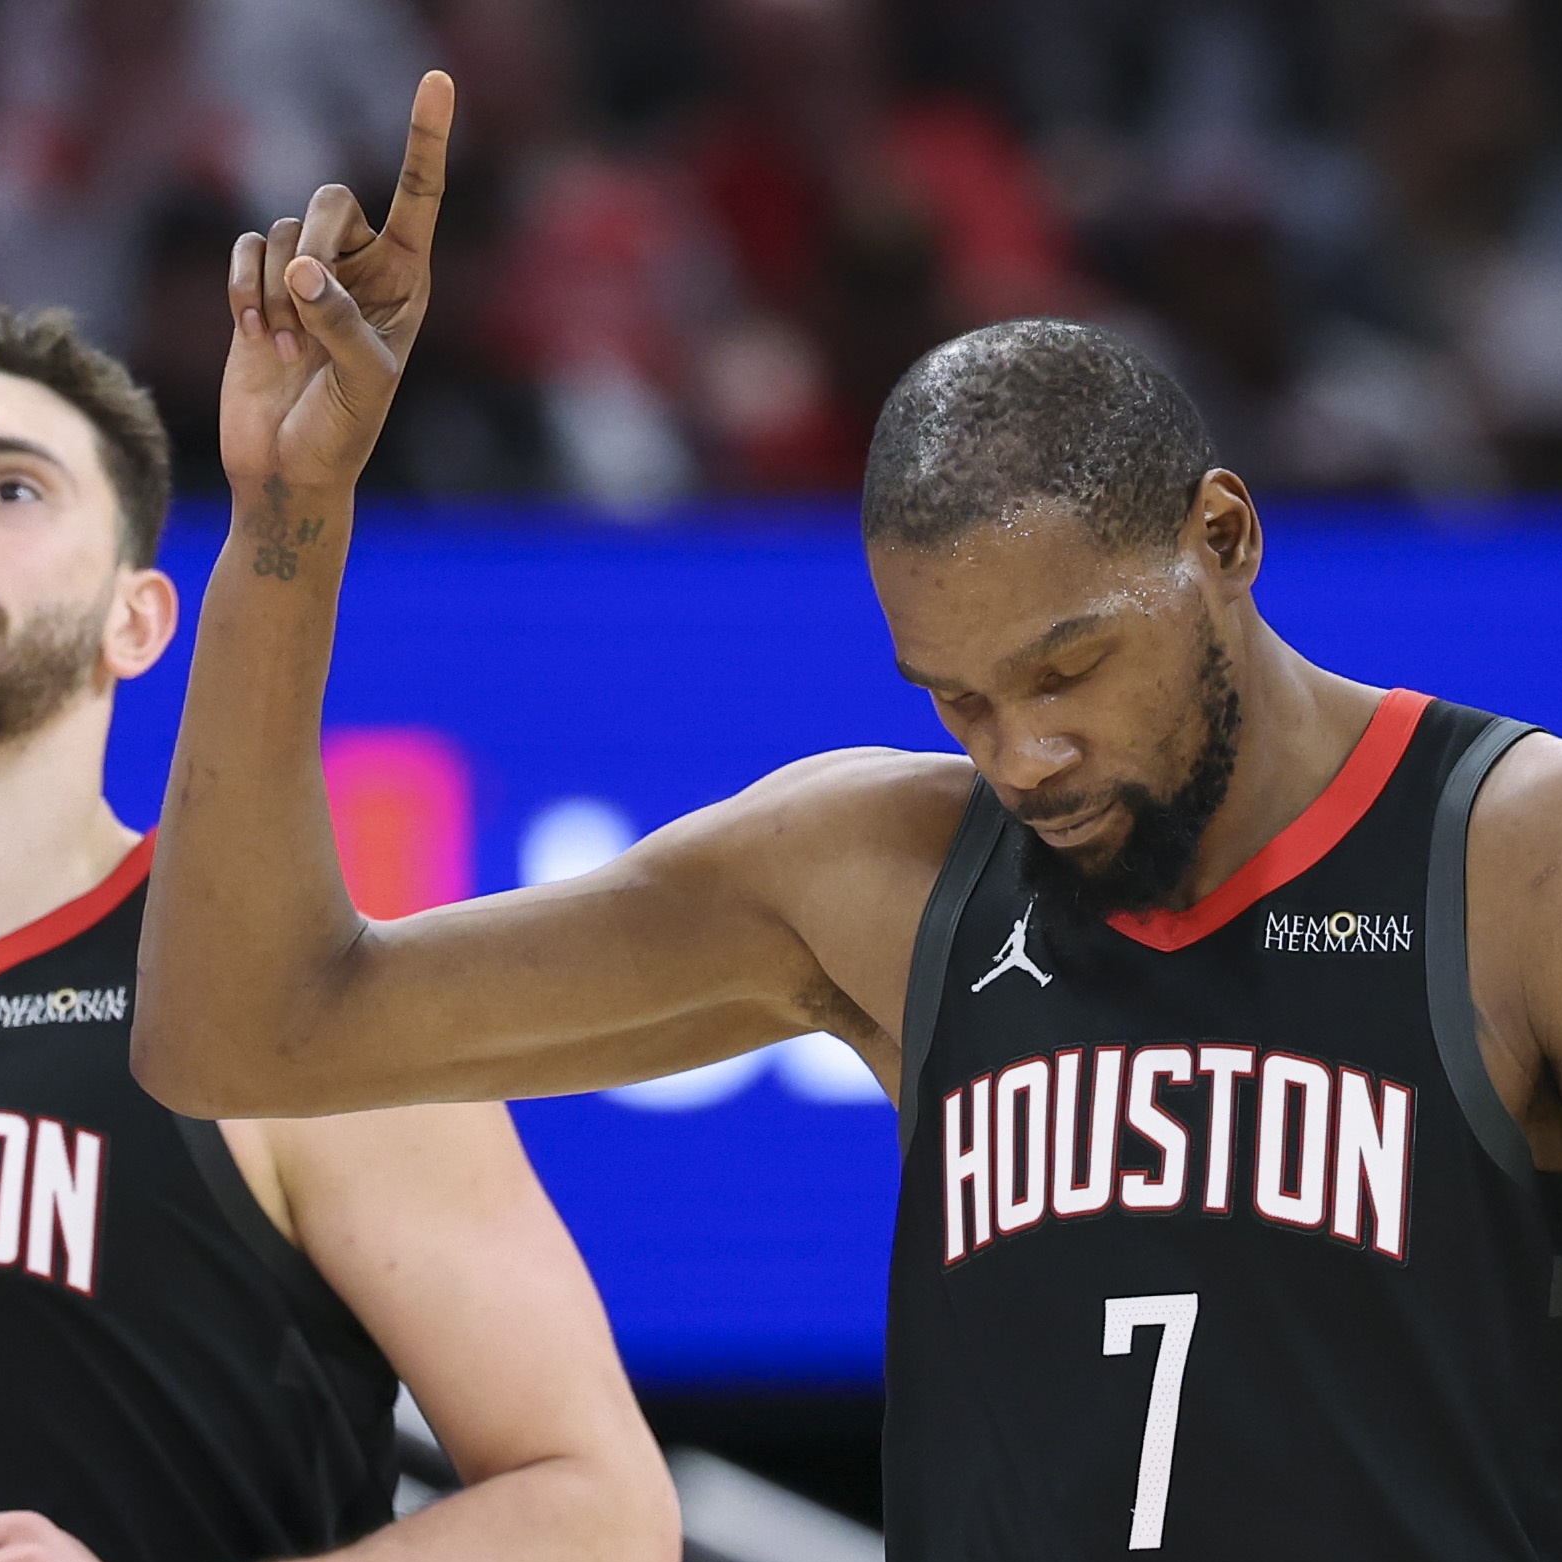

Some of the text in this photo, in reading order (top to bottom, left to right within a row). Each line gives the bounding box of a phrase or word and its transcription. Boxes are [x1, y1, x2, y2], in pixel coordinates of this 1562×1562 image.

[1264, 926, 1412, 952] HERMANN
[1265, 911, 1414, 936] MEMORIAL
[942, 1042, 1412, 1266] HOUSTON
[1102, 1293, 1199, 1552] 7
